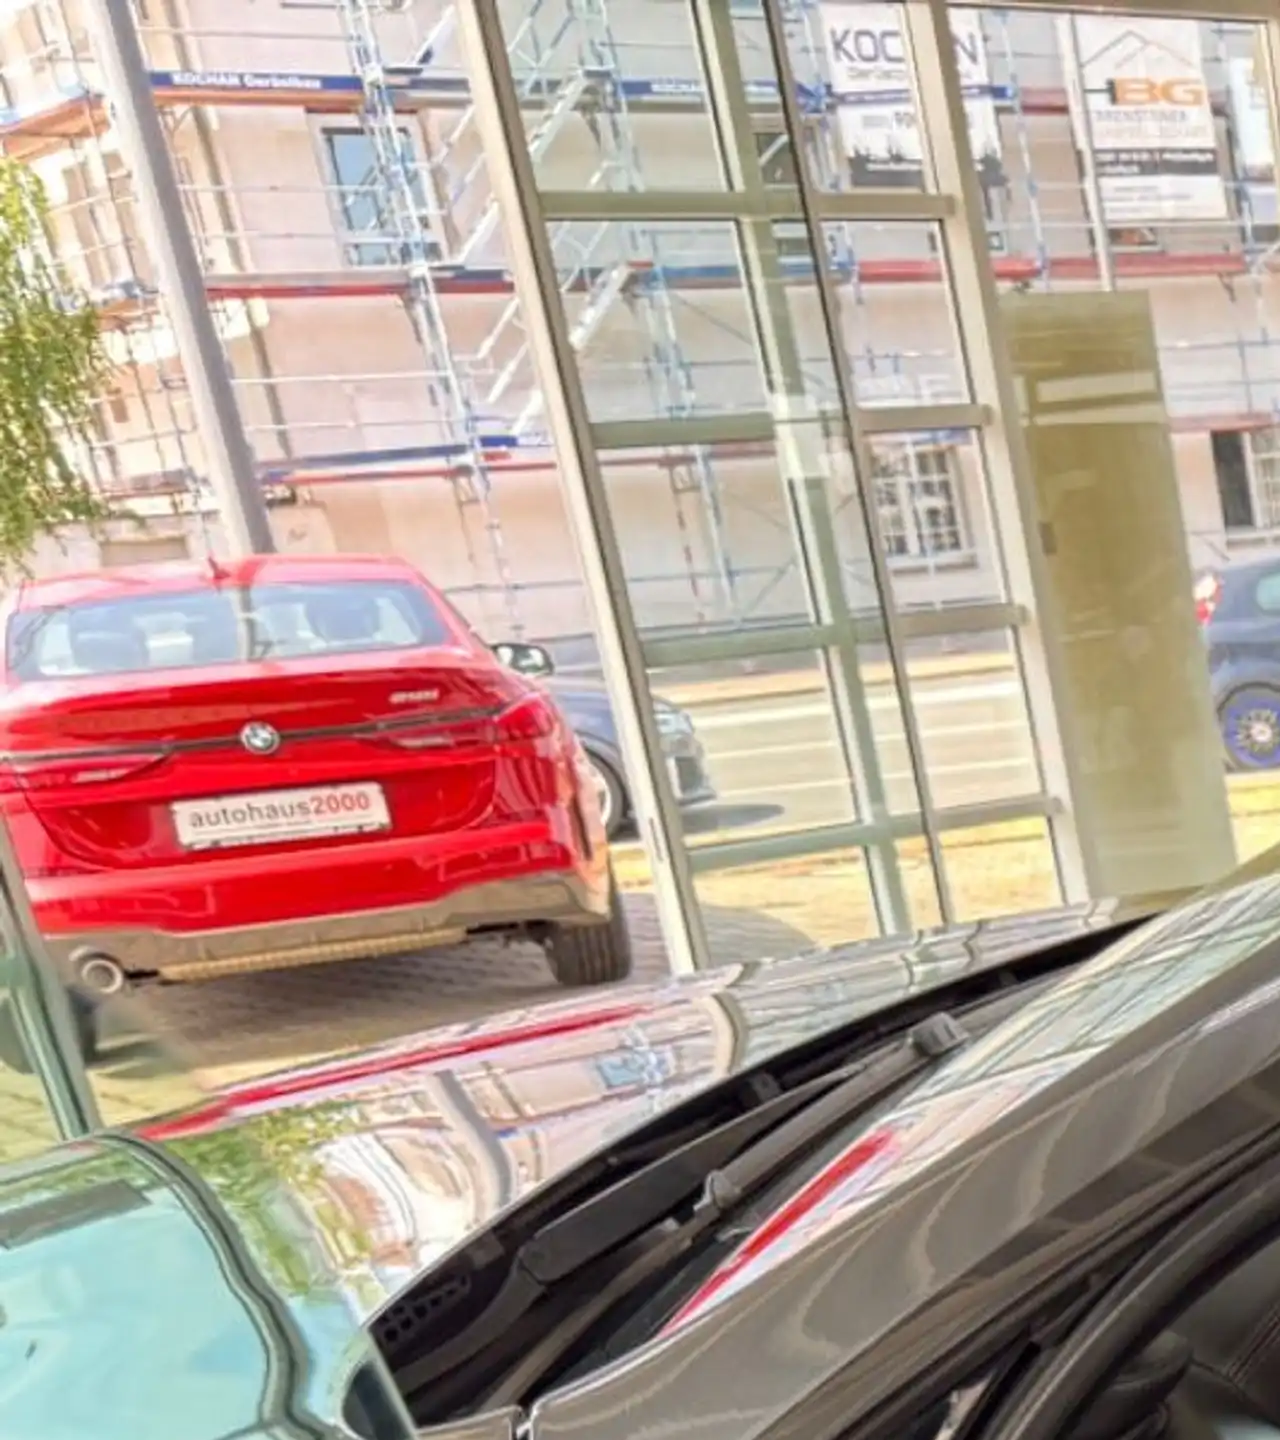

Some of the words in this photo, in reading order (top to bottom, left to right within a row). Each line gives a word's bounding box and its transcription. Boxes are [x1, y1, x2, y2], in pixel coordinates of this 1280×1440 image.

[829, 27, 980, 65] KOCN
[1114, 77, 1205, 106] BG
[188, 790, 372, 830] autohaus2000
